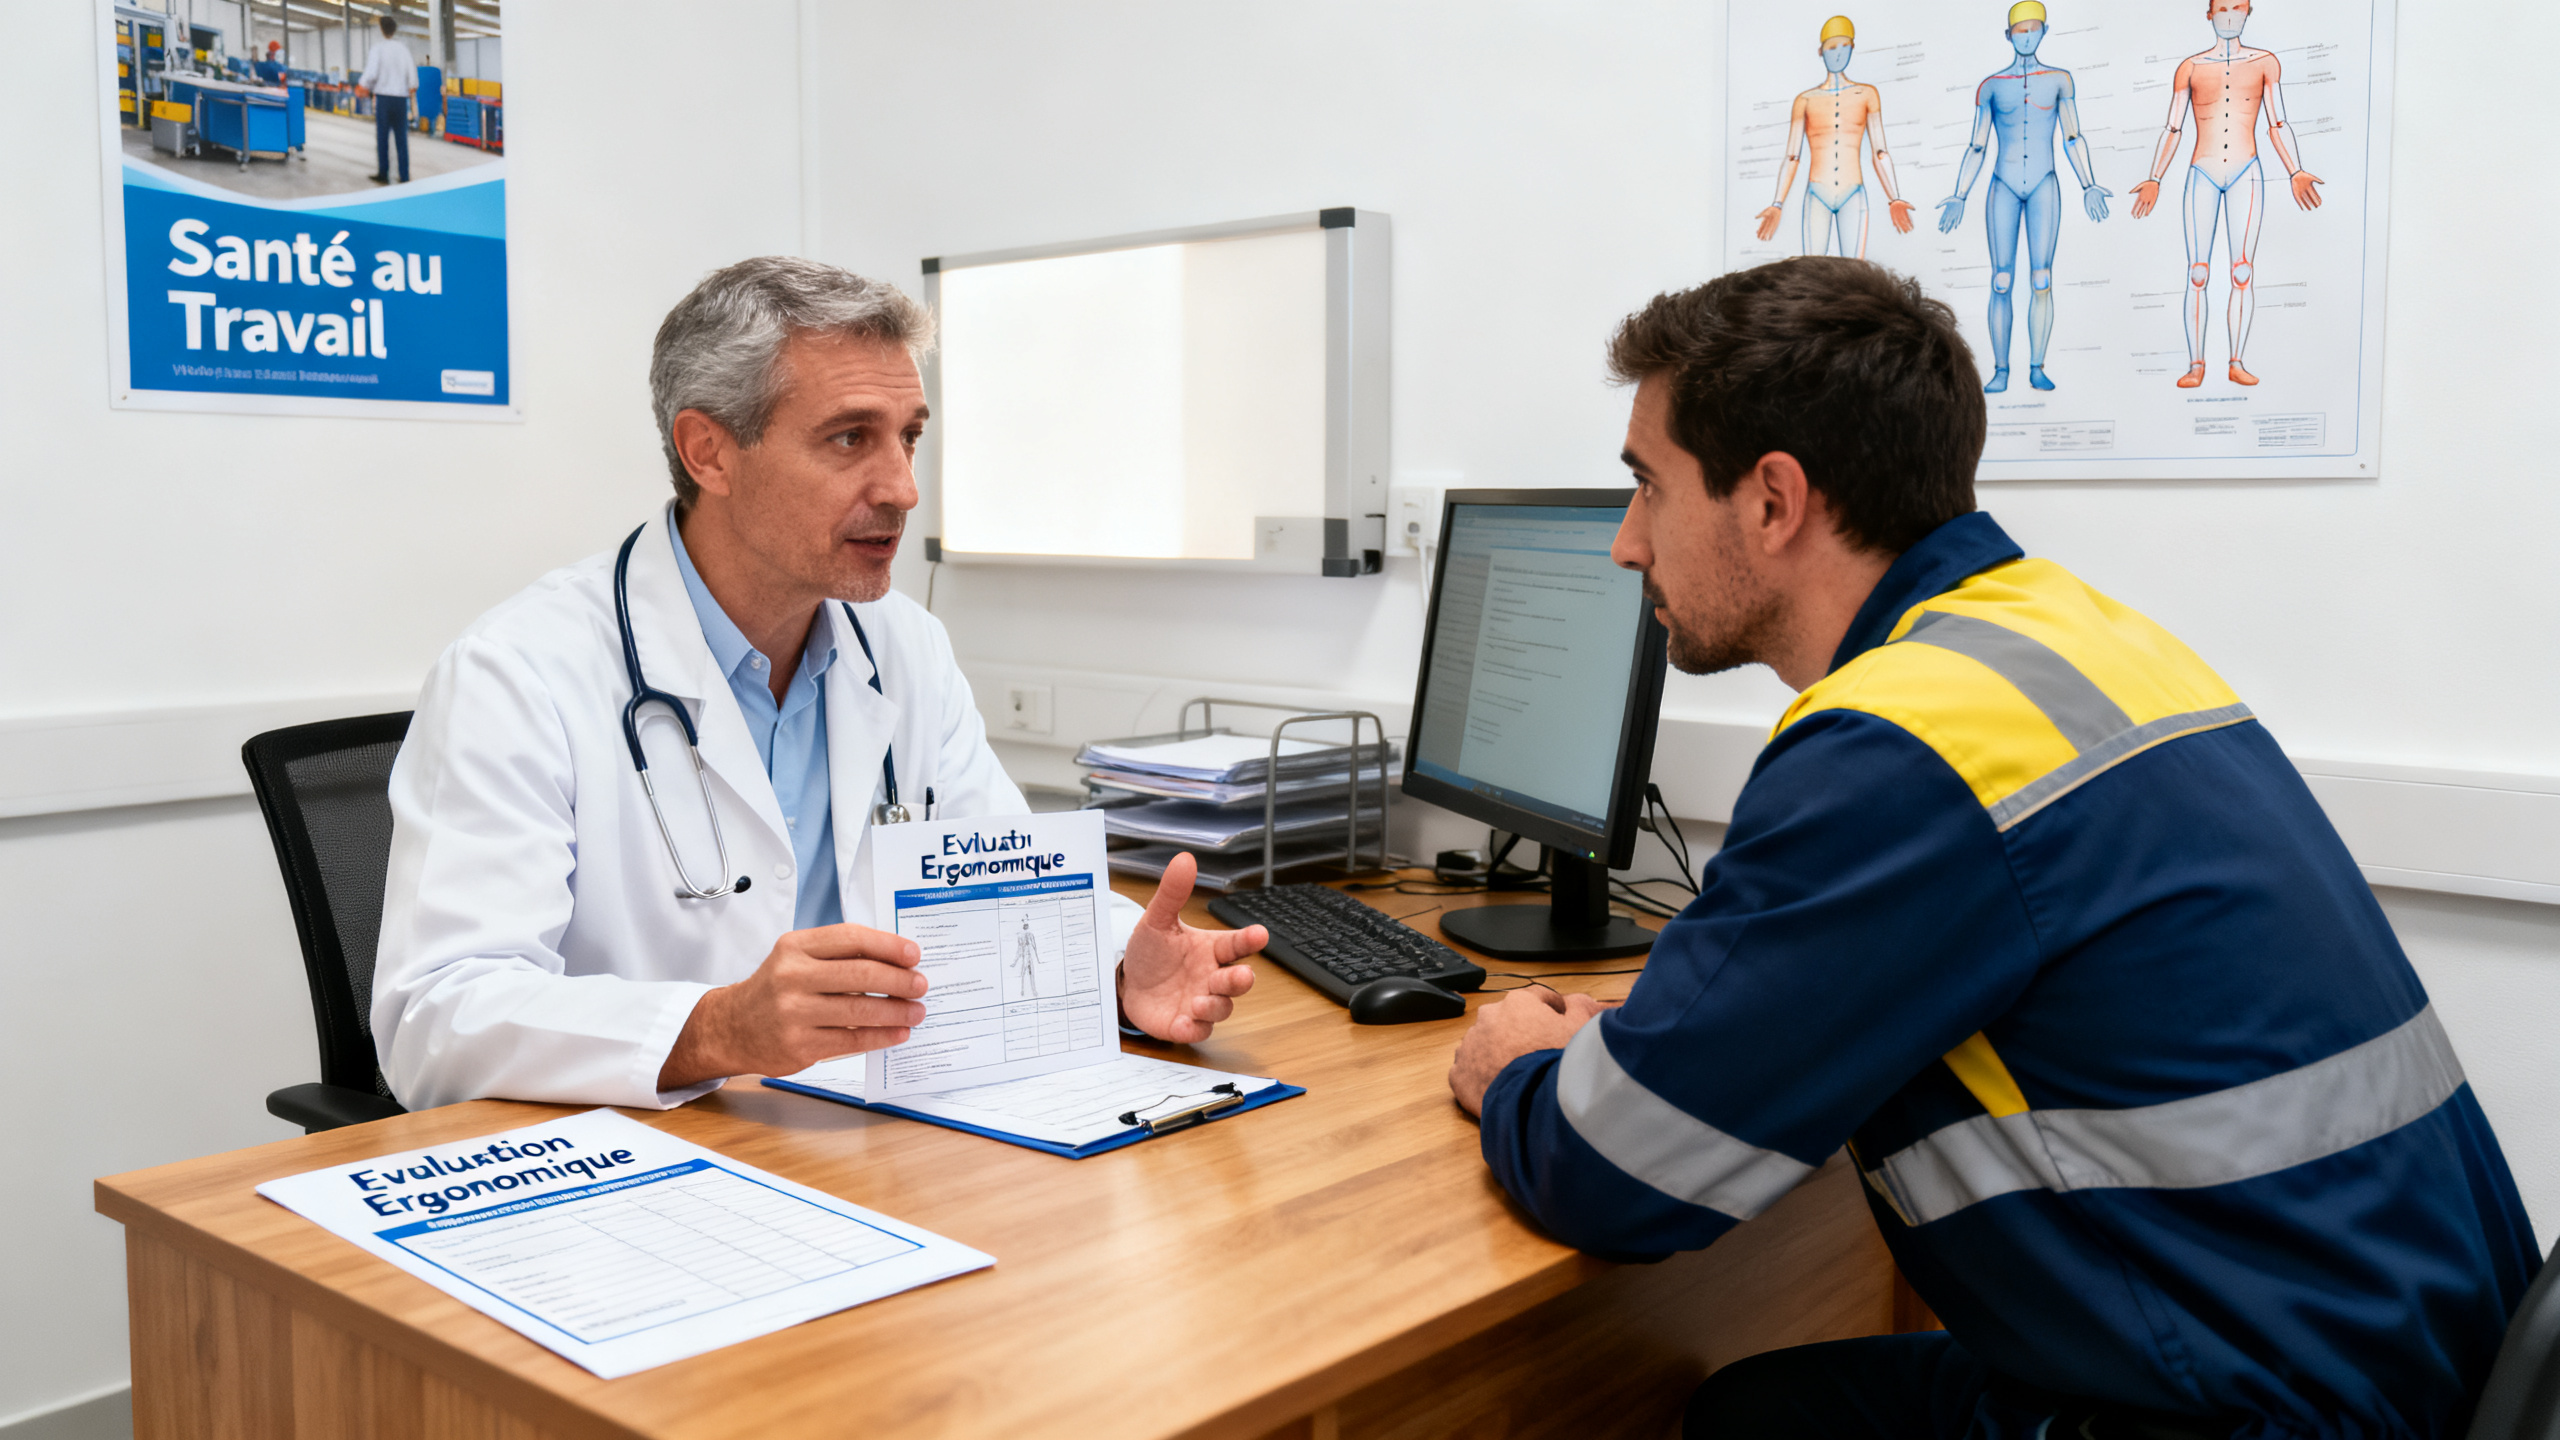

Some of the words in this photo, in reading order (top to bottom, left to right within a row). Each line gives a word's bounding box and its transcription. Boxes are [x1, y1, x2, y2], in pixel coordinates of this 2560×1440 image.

[167, 218, 357, 288] Santé
[371, 250, 443, 295] au
[167, 289, 388, 359] Travail
[363, 1147, 635, 1216] Ergonomique
